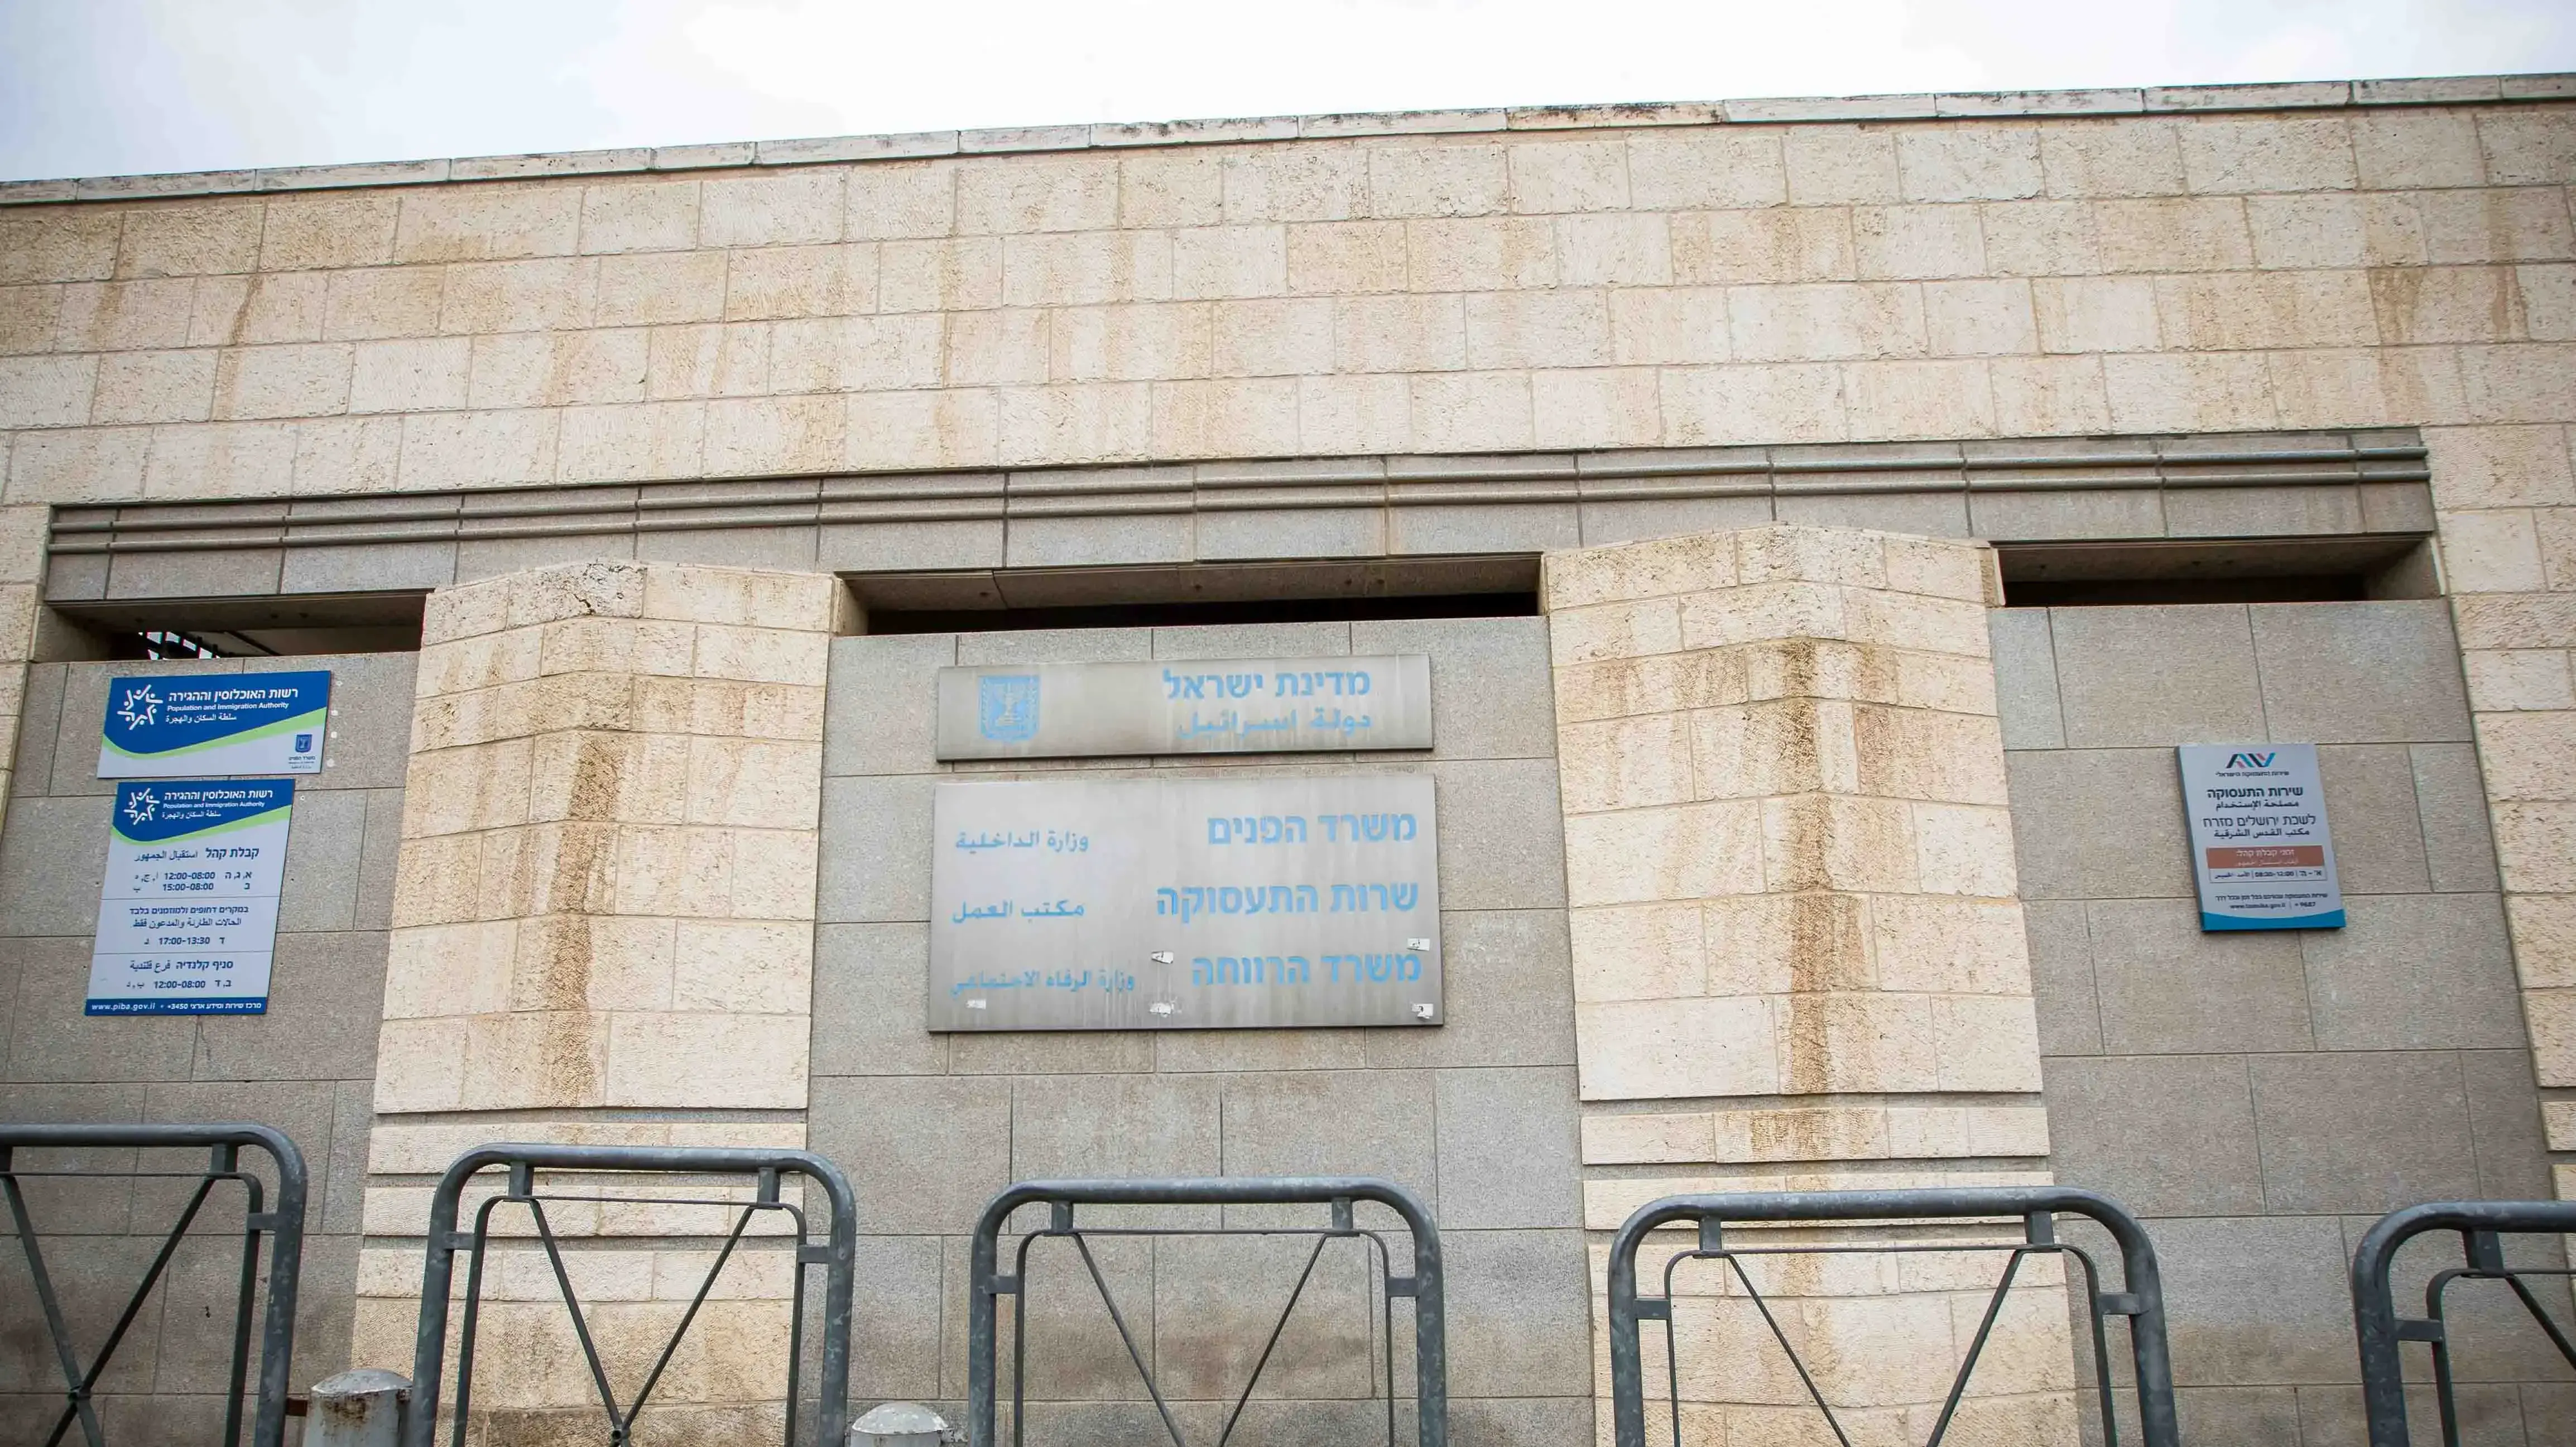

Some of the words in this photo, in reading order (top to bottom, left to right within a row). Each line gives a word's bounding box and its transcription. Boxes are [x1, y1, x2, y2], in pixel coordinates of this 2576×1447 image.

[1162, 667, 1263, 699] ישראל
[1275, 670, 1372, 698] מדינת
[169, 692, 212, 701] וההגירה
[214, 689, 266, 702] האוכלוסין
[269, 688, 299, 698] רשות
[166, 715, 192, 723] والهجرة
[194, 714, 217, 723] السكان
[1309, 706, 1373, 736] دولة
[165, 792, 200, 800] וההגירה
[203, 790, 246, 801] האוכלוסין
[2207, 788, 2265, 800] התעסוקה
[2268, 787, 2303, 796] שירות
[2203, 818, 2233, 828] מזרח
[2237, 815, 2279, 826] ירושלים
[2282, 814, 2316, 825] לשכת
[1207, 815, 1308, 844] הפנים
[1318, 813, 1417, 843] משרד
[2253, 828, 2282, 838] القدس
[2285, 828, 2310, 838] مكتب
[2214, 829, 2250, 839] الشرقية
[955, 830, 1040, 854] الداخلية
[1046, 829, 1089, 853] وزارة
[134, 850, 167, 861] الجمهور
[169, 849, 198, 860] استقبال
[205, 847, 226, 860] קהל
[229, 847, 259, 860] קבלת
[164, 872, 215, 880] 12:00-08:00
[162, 883, 214, 891] 15:00-08:00
[1329, 882, 1419, 913] שרות
[1156, 884, 1319, 924] התעסוקה
[219, 906, 248, 915] במקרים
[952, 900, 1013, 924] العمل
[1021, 899, 1085, 923] مكتب
[175, 960, 209, 972] קלנדיה
[212, 961, 234, 970] סניף
[1191, 955, 1310, 986] הרווחה
[1320, 953, 1422, 984] משרד
[154, 980, 206, 989] 12:00-08:00
[1046, 969, 1091, 992] الرفاه
[1098, 969, 1135, 993] وزارة
[92, 1003, 155, 1011] www.piba.gov.il
